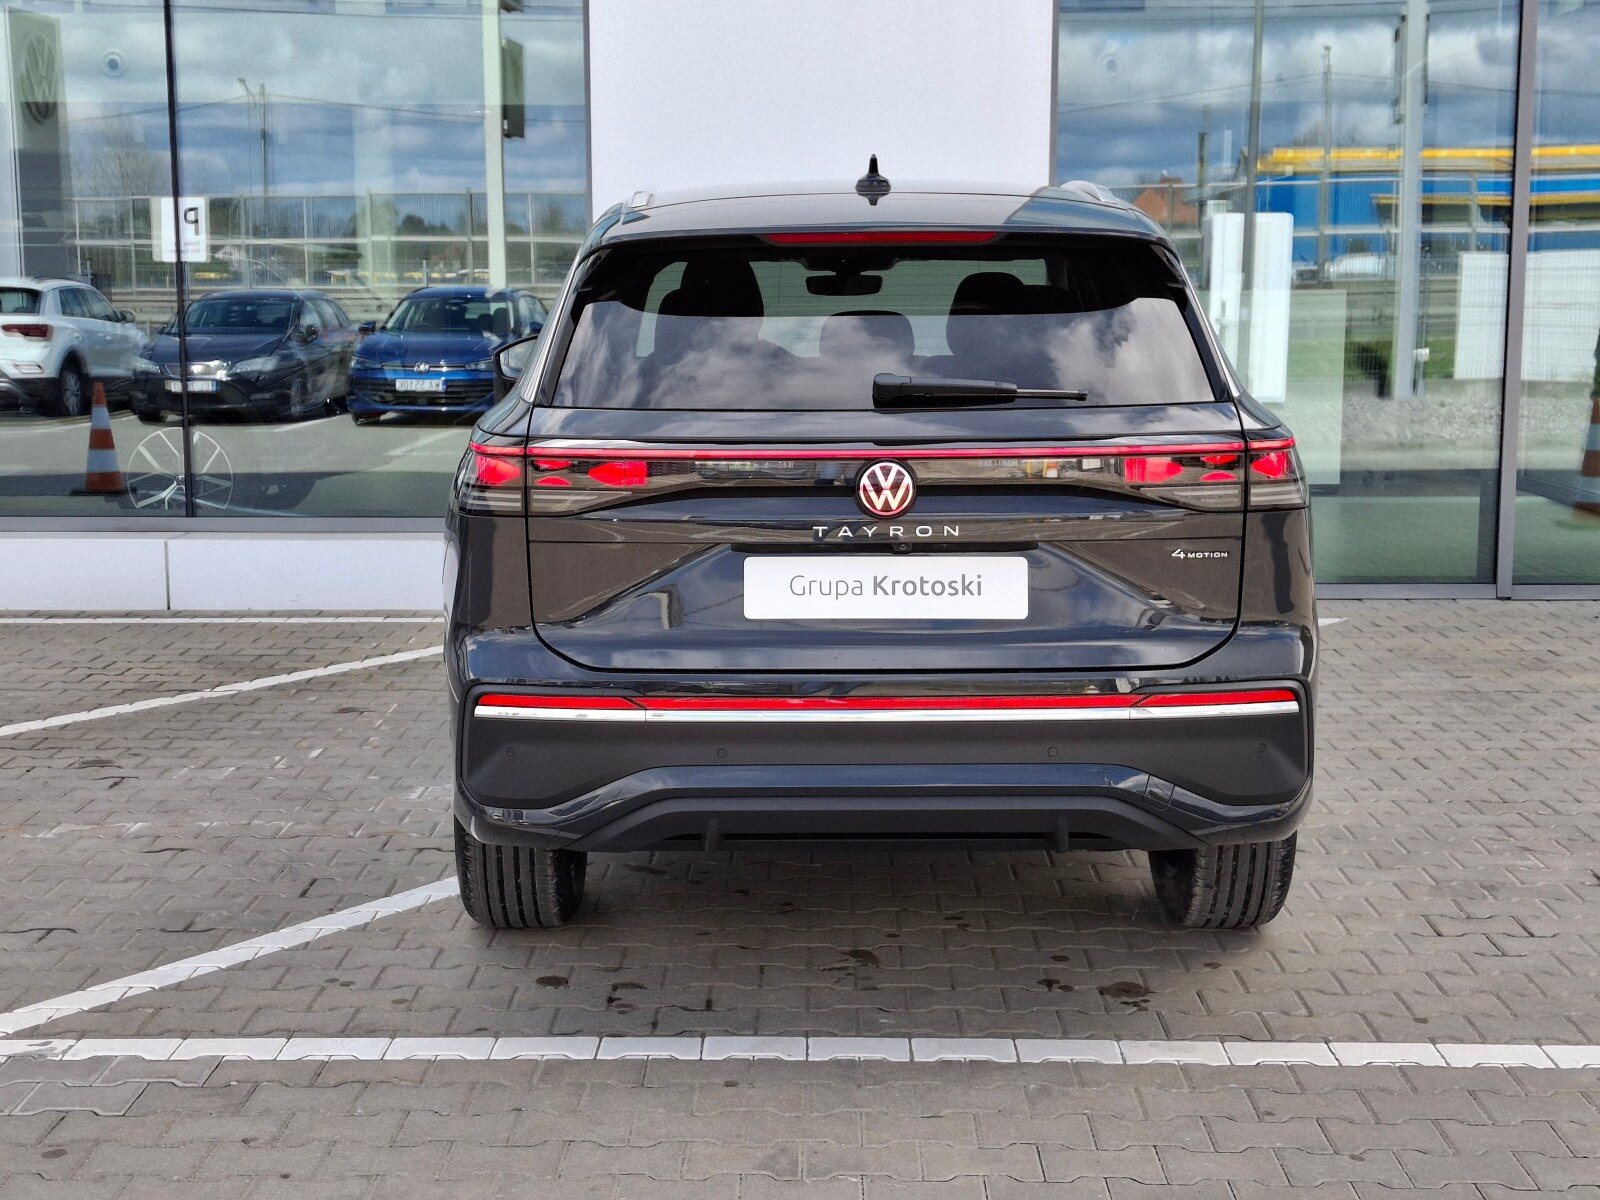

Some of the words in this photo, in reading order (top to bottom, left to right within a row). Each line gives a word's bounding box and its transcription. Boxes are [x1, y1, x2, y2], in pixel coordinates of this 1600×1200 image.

[860, 462, 913, 516] VW
[812, 525, 960, 538] TAYRON
[1171, 548, 1229, 560] 4MOTION
[789, 575, 863, 601] Grupa
[873, 573, 982, 597] Krotoski
